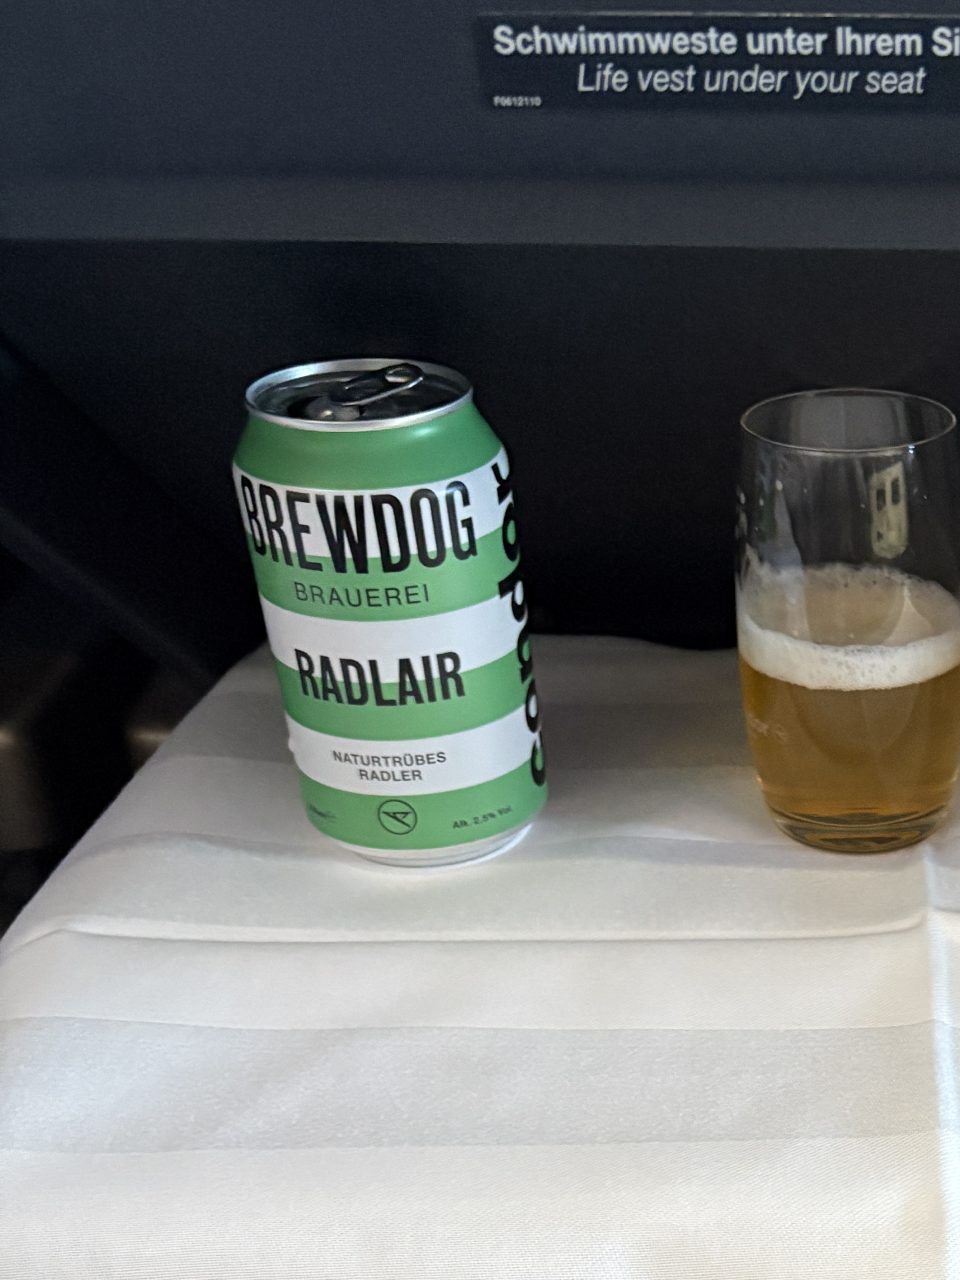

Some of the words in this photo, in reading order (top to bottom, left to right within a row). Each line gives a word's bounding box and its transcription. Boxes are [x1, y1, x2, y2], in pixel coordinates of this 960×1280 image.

[493, 24, 738, 56] Schwimmweste
[746, 30, 827, 55] unter
[836, 27, 923, 56] Ihrem
[577, 63, 628, 93] Life
[637, 65, 695, 93] vest
[704, 64, 788, 93] under
[793, 70, 859, 99] your
[865, 67, 926, 94] seat
[241, 474, 478, 574] BREWDOG
[294, 581, 430, 608] BRAUEREI
[294, 648, 466, 707] RADLAIR
[332, 750, 447, 767] NATURTRÜBES
[359, 769, 423, 782] RADLER
